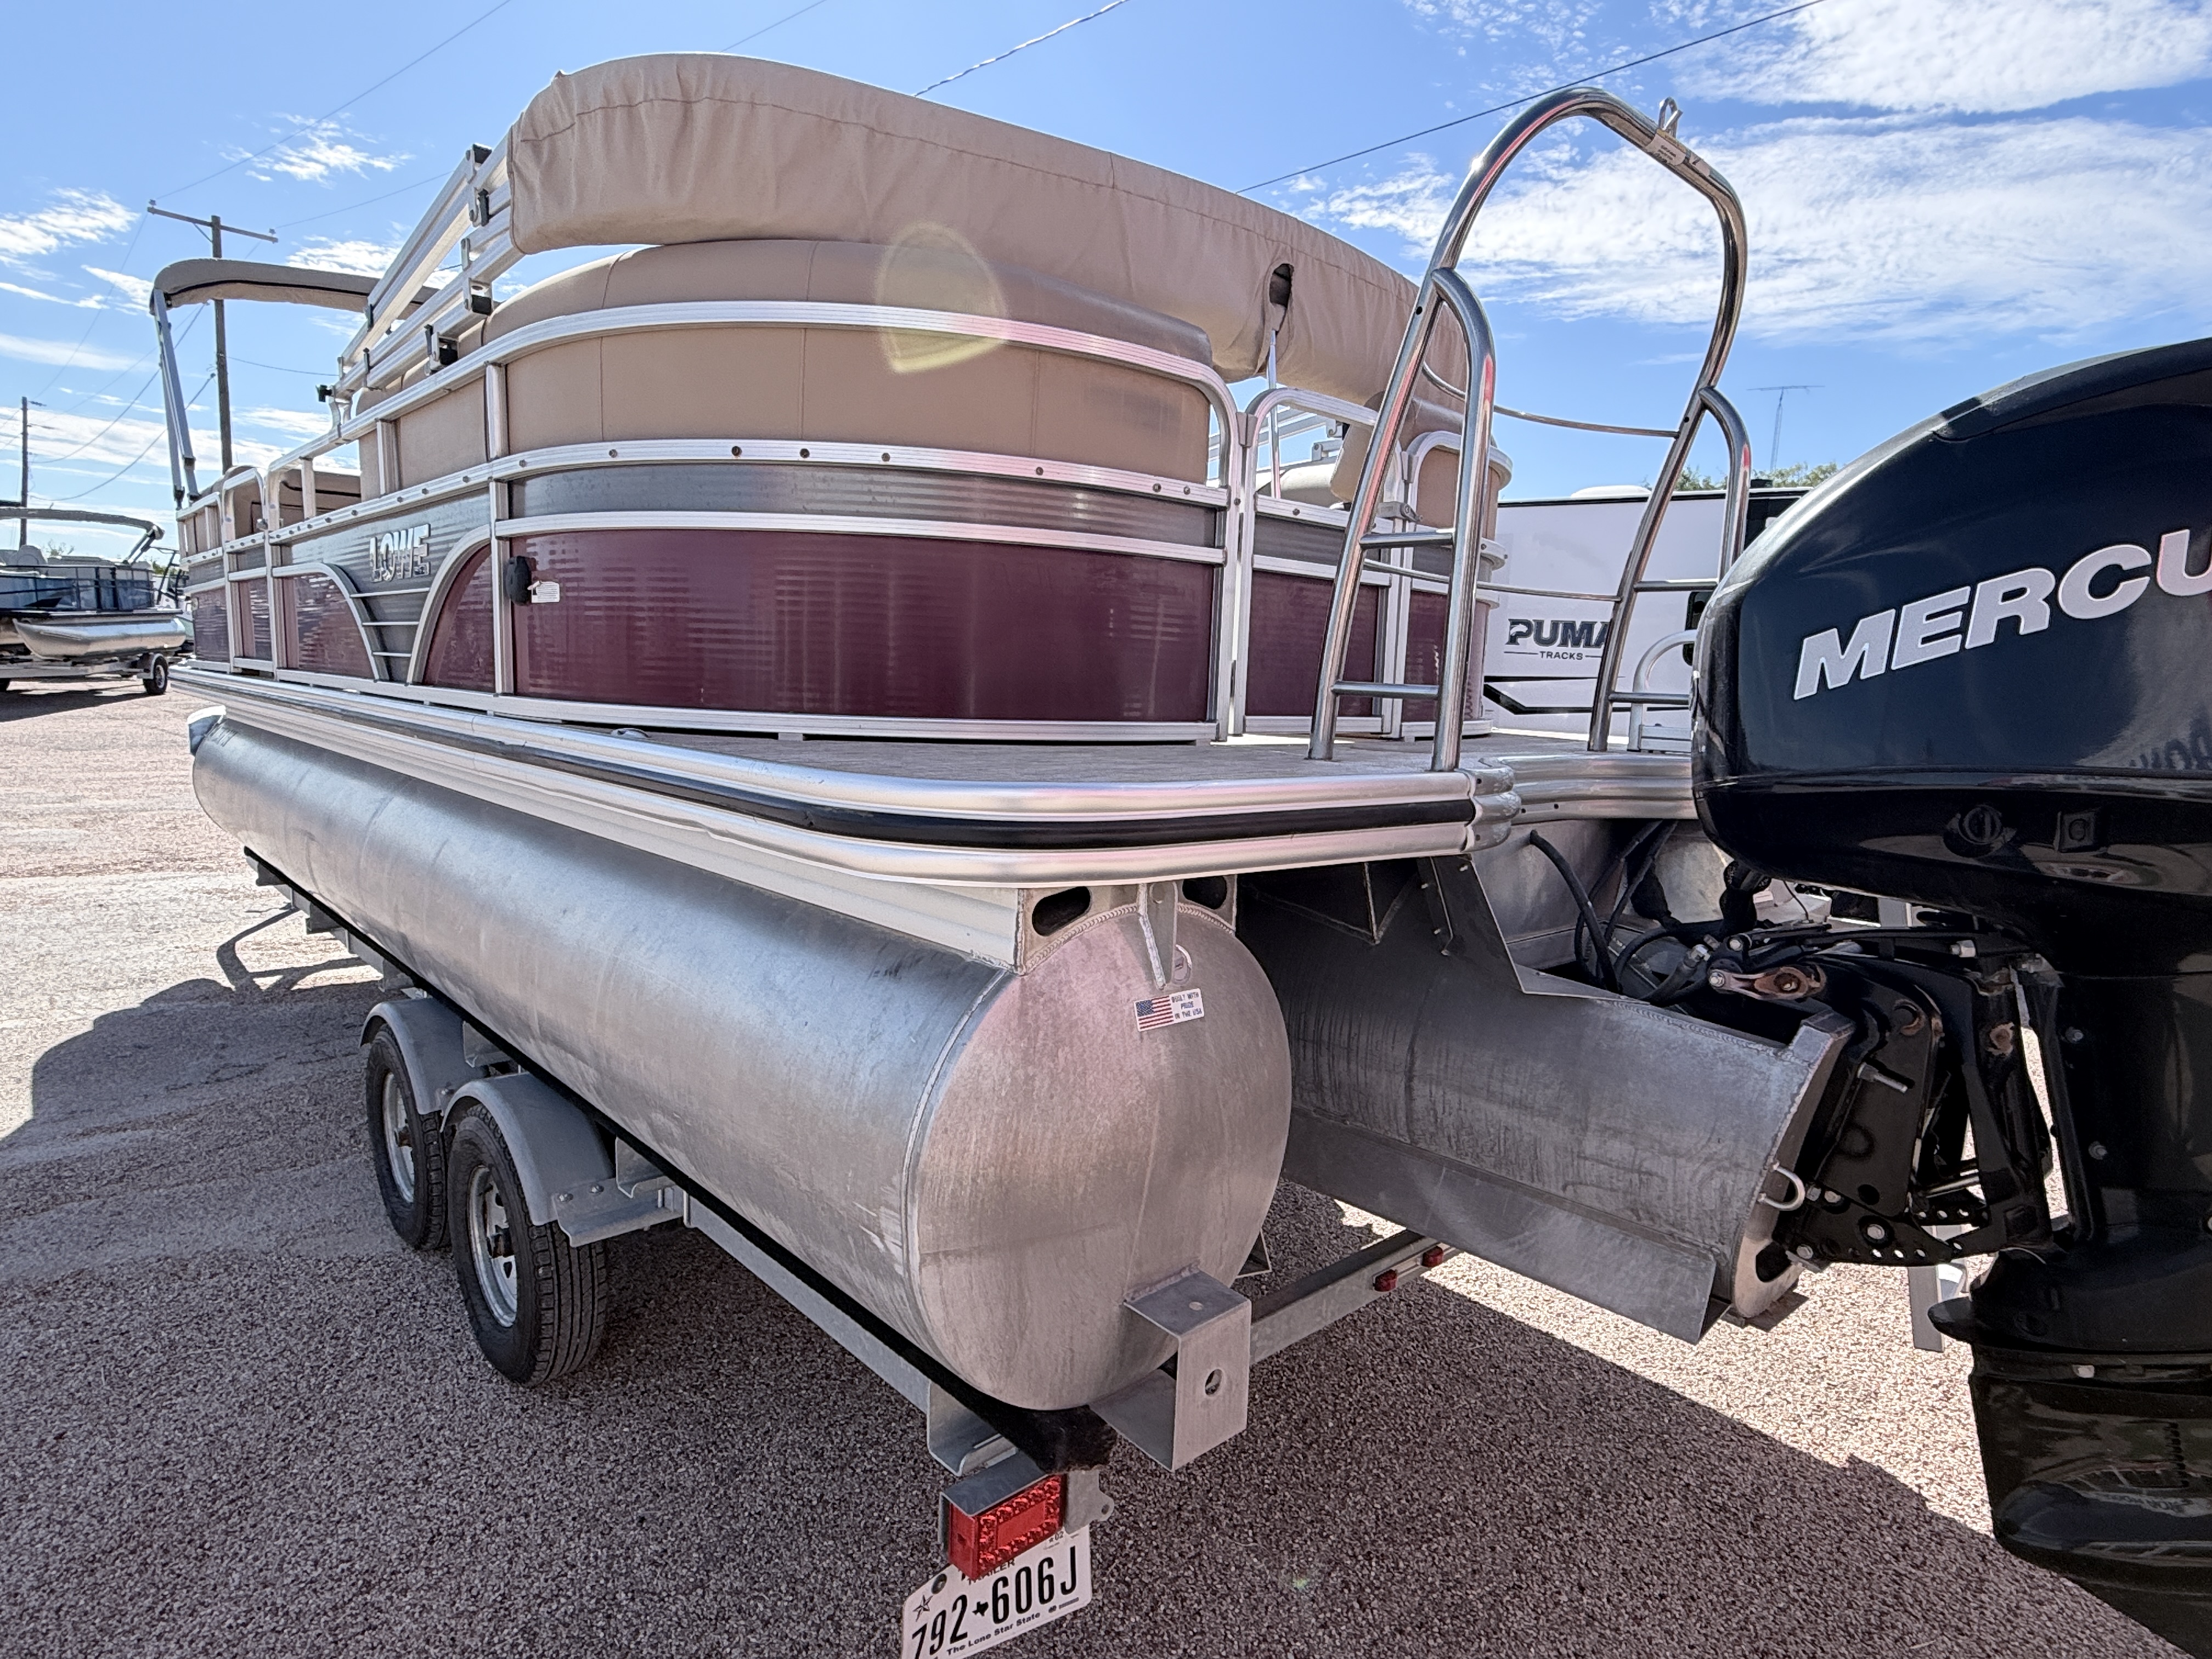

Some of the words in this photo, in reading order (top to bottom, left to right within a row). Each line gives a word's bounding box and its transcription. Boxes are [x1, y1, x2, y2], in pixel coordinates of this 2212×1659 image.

[370, 523, 431, 583] LOWE
[1794, 529, 2212, 701] MERCU
[1539, 651, 1583, 660] TRACKS
[1187, 991, 1199, 1000] WITH
[1181, 1001, 1194, 1009] PRIDE
[1182, 1010, 1191, 1018] THE
[1193, 1008, 1202, 1016] USA
[946, 1644, 966, 1656] The
[968, 1633, 992, 1647] Lone
[994, 1623, 1014, 1636] Star
[1017, 1612, 1041, 1627] State
